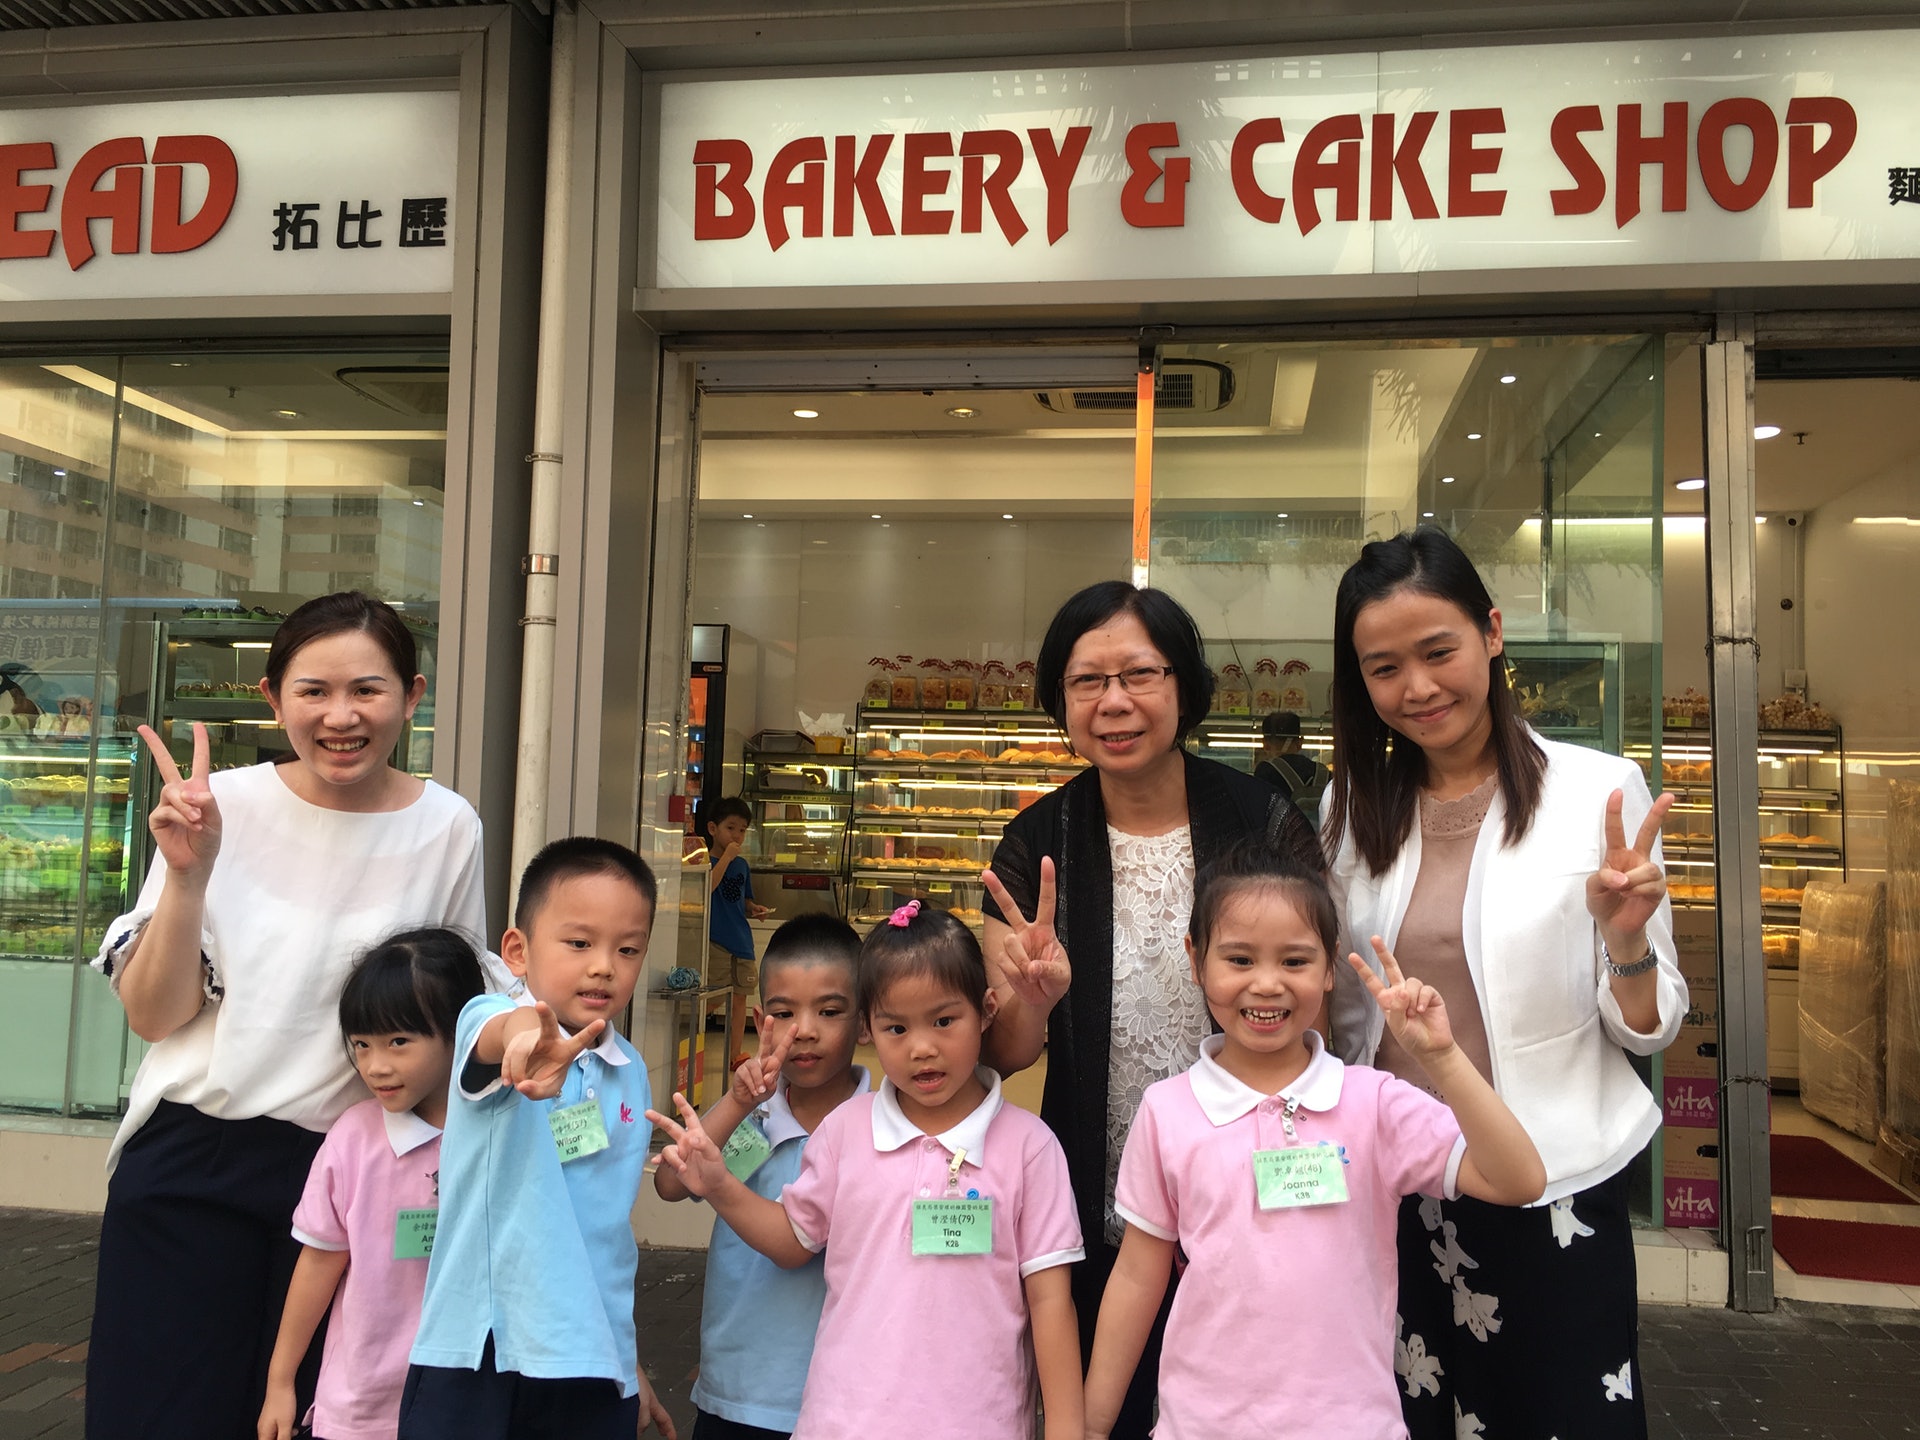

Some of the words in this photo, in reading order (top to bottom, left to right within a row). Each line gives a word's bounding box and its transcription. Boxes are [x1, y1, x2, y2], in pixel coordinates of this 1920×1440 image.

[693, 126, 1092, 252] BAKERY
[1121, 122, 1190, 228] &
[1231, 107, 1507, 237] CAKE
[1549, 96, 1858, 230] SHOP
[272, 197, 447, 251] 拓比歷
[1666, 1085, 1714, 1111] vita
[556, 1134, 583, 1148] Wilson
[1282, 1179, 1319, 1190] Joanna
[1666, 1186, 1714, 1213] vita
[943, 1228, 962, 1238] Tina
[945, 1240, 960, 1249] K2B
